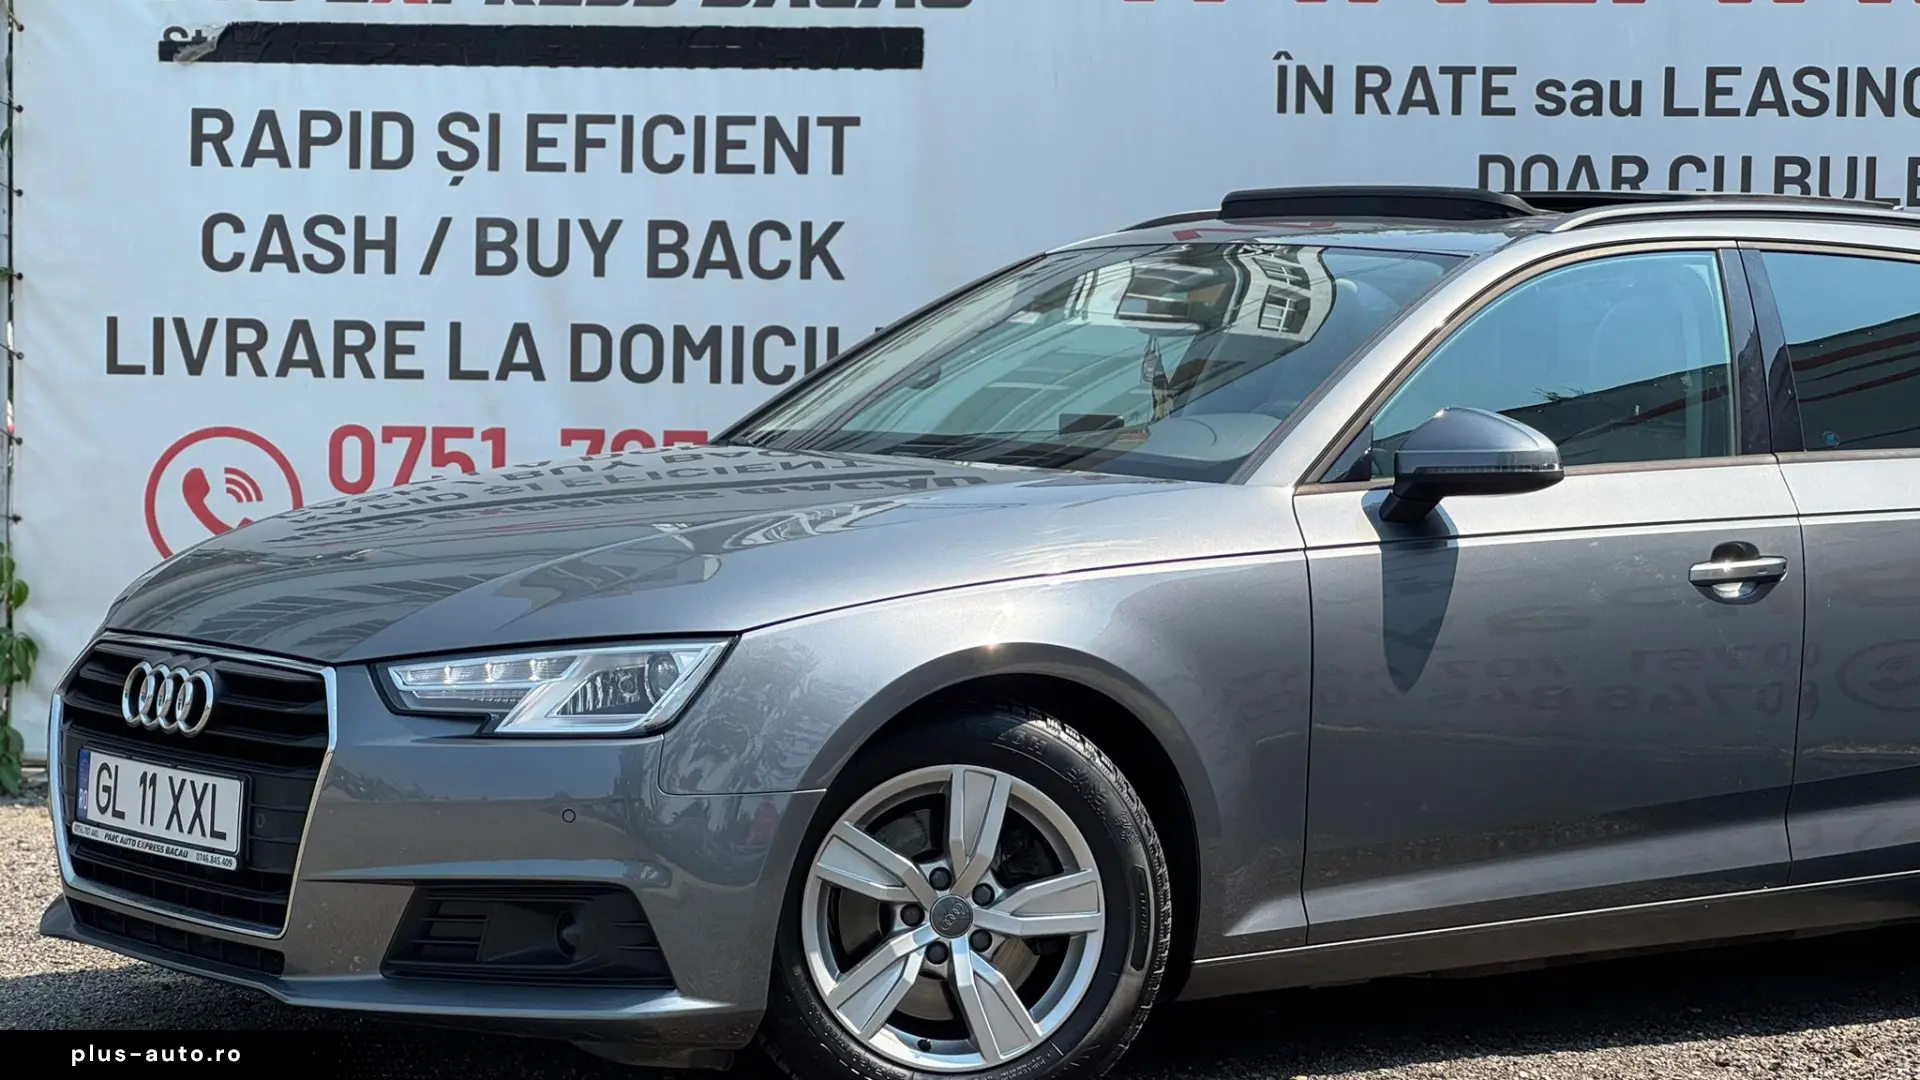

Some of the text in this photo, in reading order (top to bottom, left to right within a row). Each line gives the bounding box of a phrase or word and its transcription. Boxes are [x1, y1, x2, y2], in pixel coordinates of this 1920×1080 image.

[1272, 51, 1334, 115] ÎN
[1356, 66, 1517, 117] RATE
[1534, 79, 1643, 118] sau
[190, 107, 861, 186] RAPID ȘI EFICIENT
[1478, 154, 1649, 191] DOAR
[1669, 155, 1752, 193] CU
[201, 212, 845, 281] CASH / BUY BACK
[106, 316, 425, 380] LIVRARE
[448, 321, 546, 382] LA
[329, 424, 505, 494] 0751
[95, 761, 227, 841] GL 11 XXL
[120, 836, 137, 847] AUTO
[136, 840, 165, 854] EXPRESS
